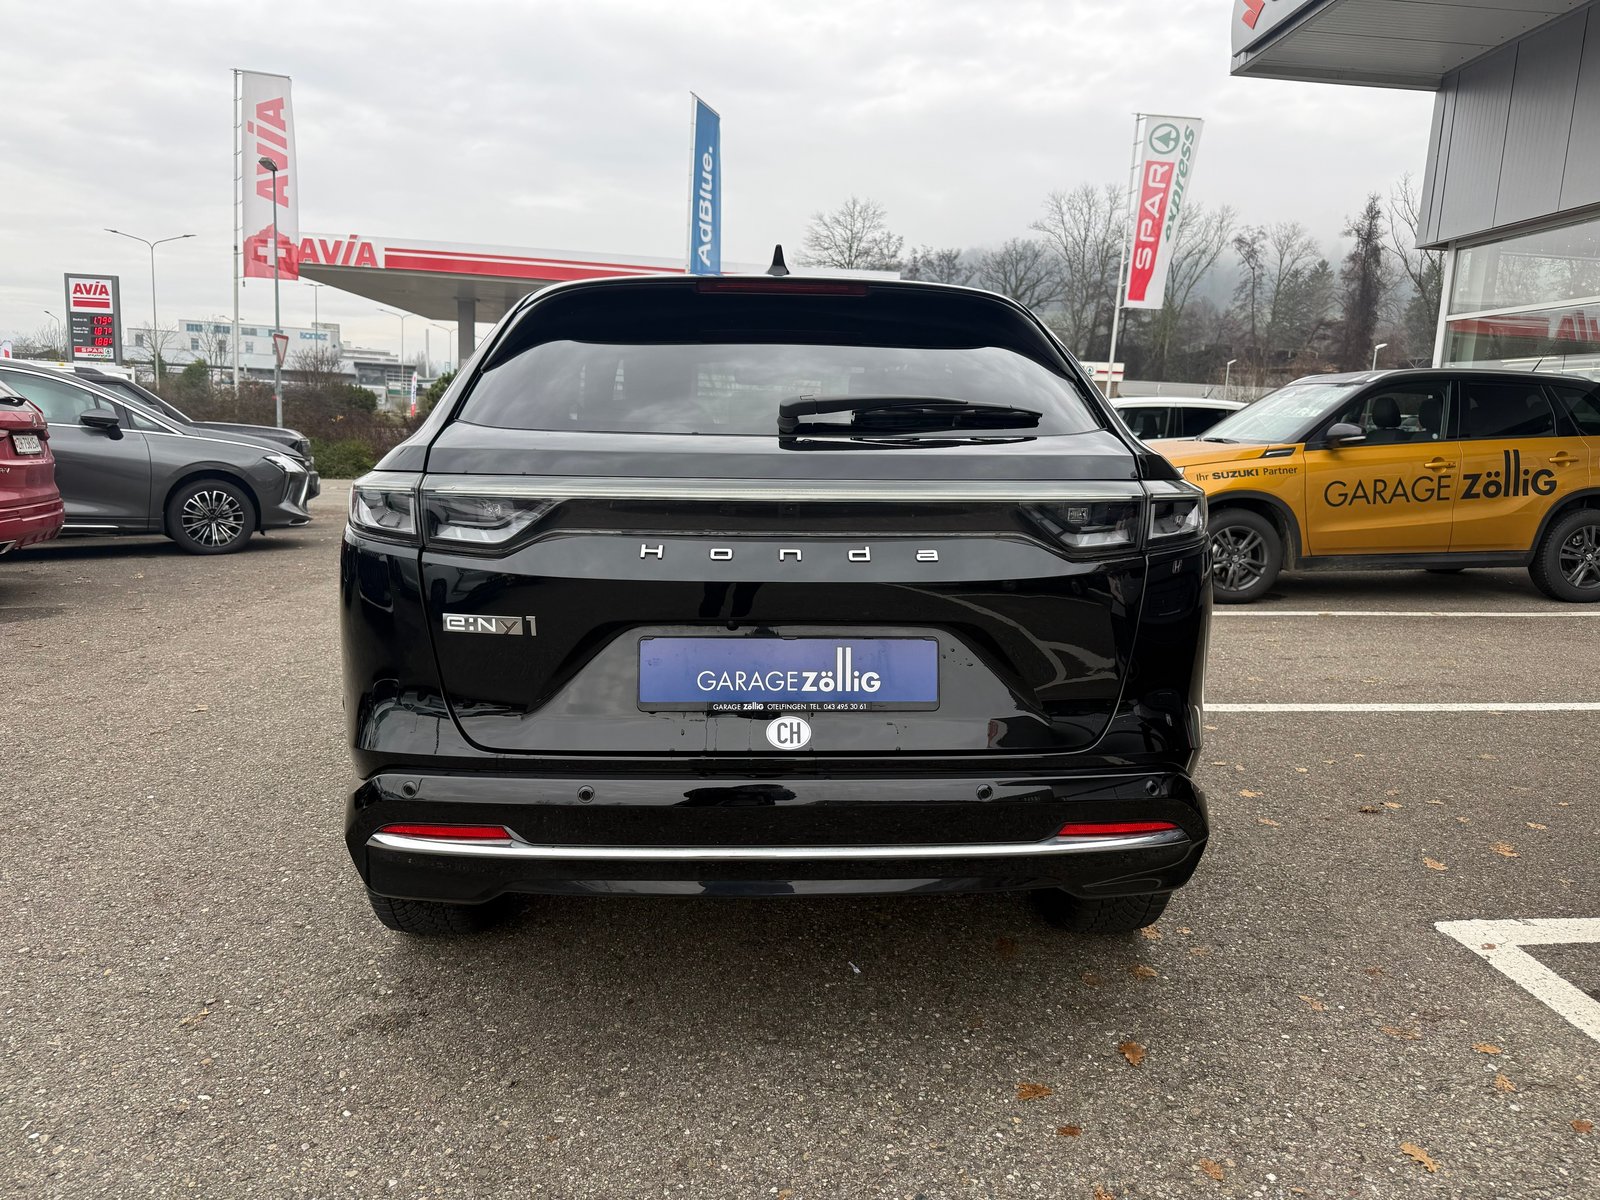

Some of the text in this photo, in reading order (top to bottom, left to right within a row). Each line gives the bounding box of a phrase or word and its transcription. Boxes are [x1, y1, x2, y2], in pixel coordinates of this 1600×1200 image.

[1166, 125, 1195, 243] express
[1135, 164, 1169, 270] SPAR
[1196, 467, 1298, 481] Ihr SUZUKI Partner
[1324, 475, 1451, 507] GARAGE
[696, 670, 798, 692] GARAGE
[777, 722, 801, 744] CH
